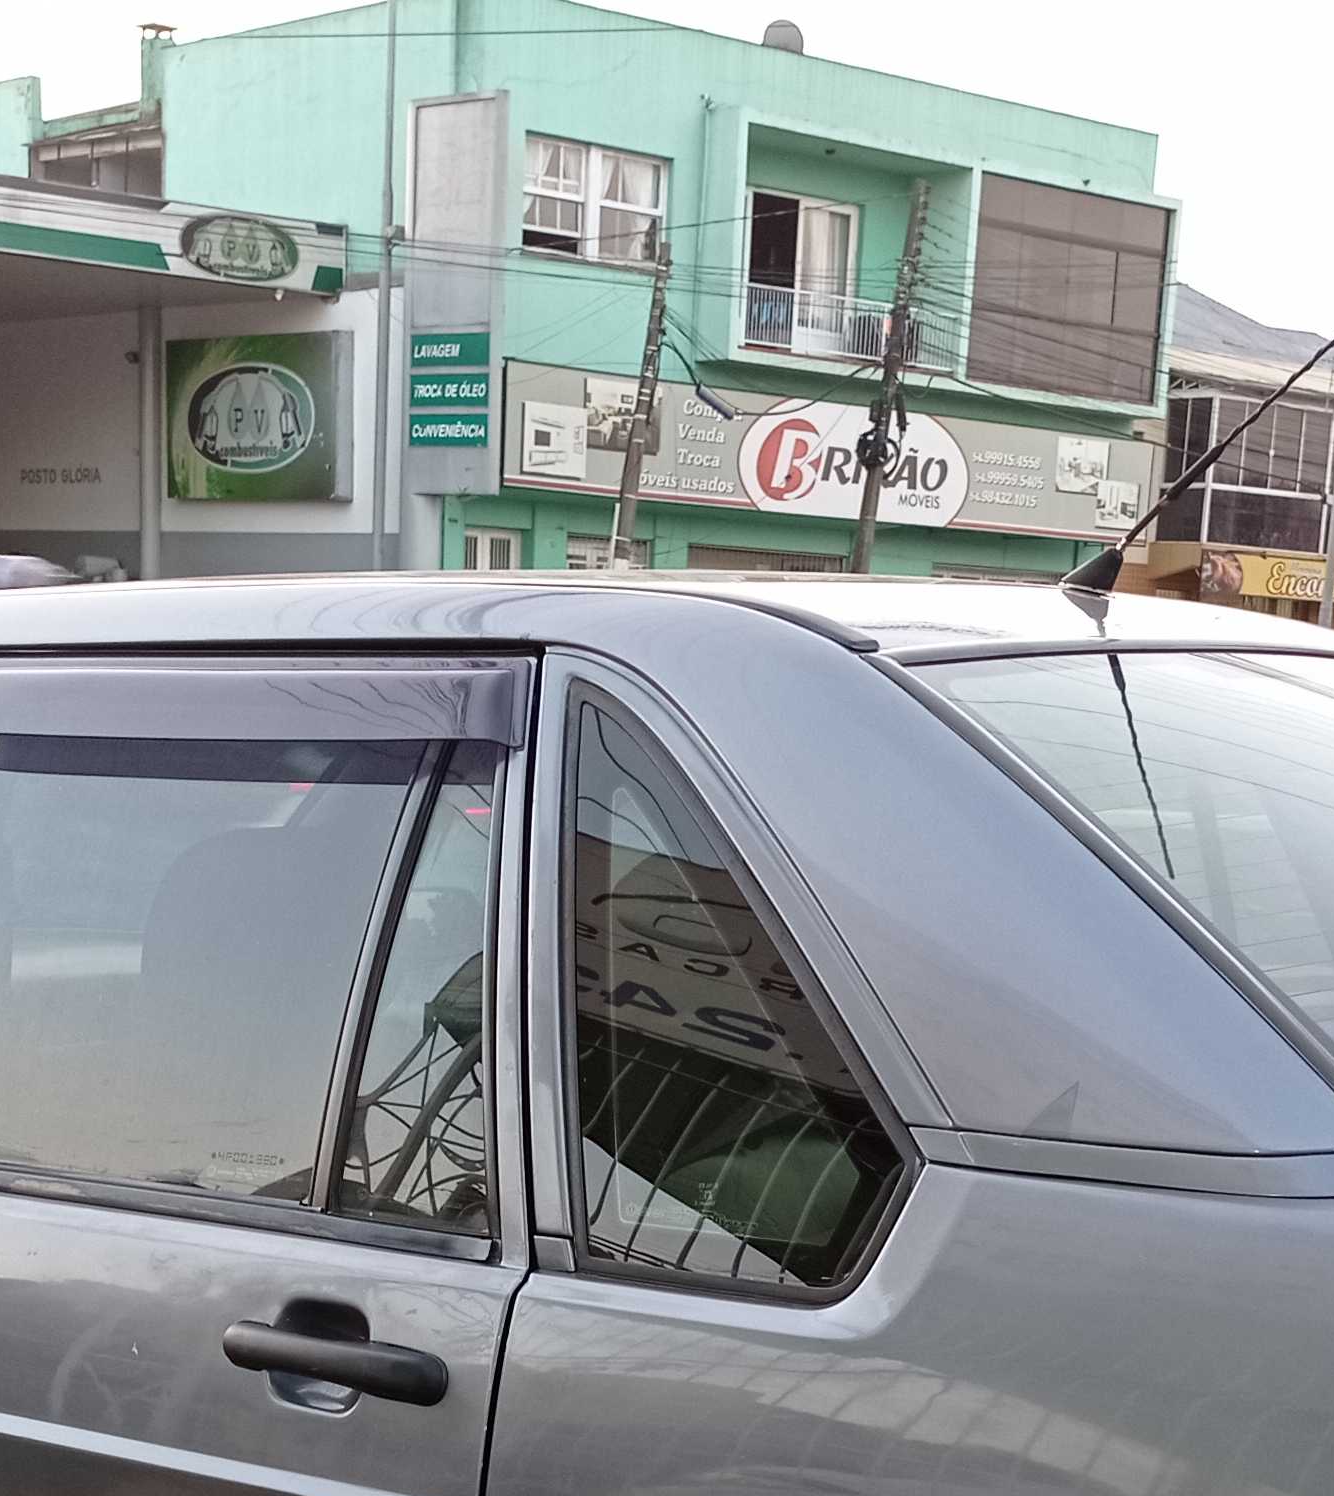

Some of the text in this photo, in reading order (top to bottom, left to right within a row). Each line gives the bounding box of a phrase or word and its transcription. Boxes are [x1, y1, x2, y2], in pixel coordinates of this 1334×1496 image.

[413, 344, 460, 358] LAVAGEM
[413, 380, 487, 399] TROCA DE ÓLEO
[411, 420, 486, 439] CONVENIÊNCIA
[677, 424, 726, 444] Venda
[677, 447, 721, 468] Troca
[20, 468, 57, 484] POSTO
[623, 469, 735, 495] óveis usados
